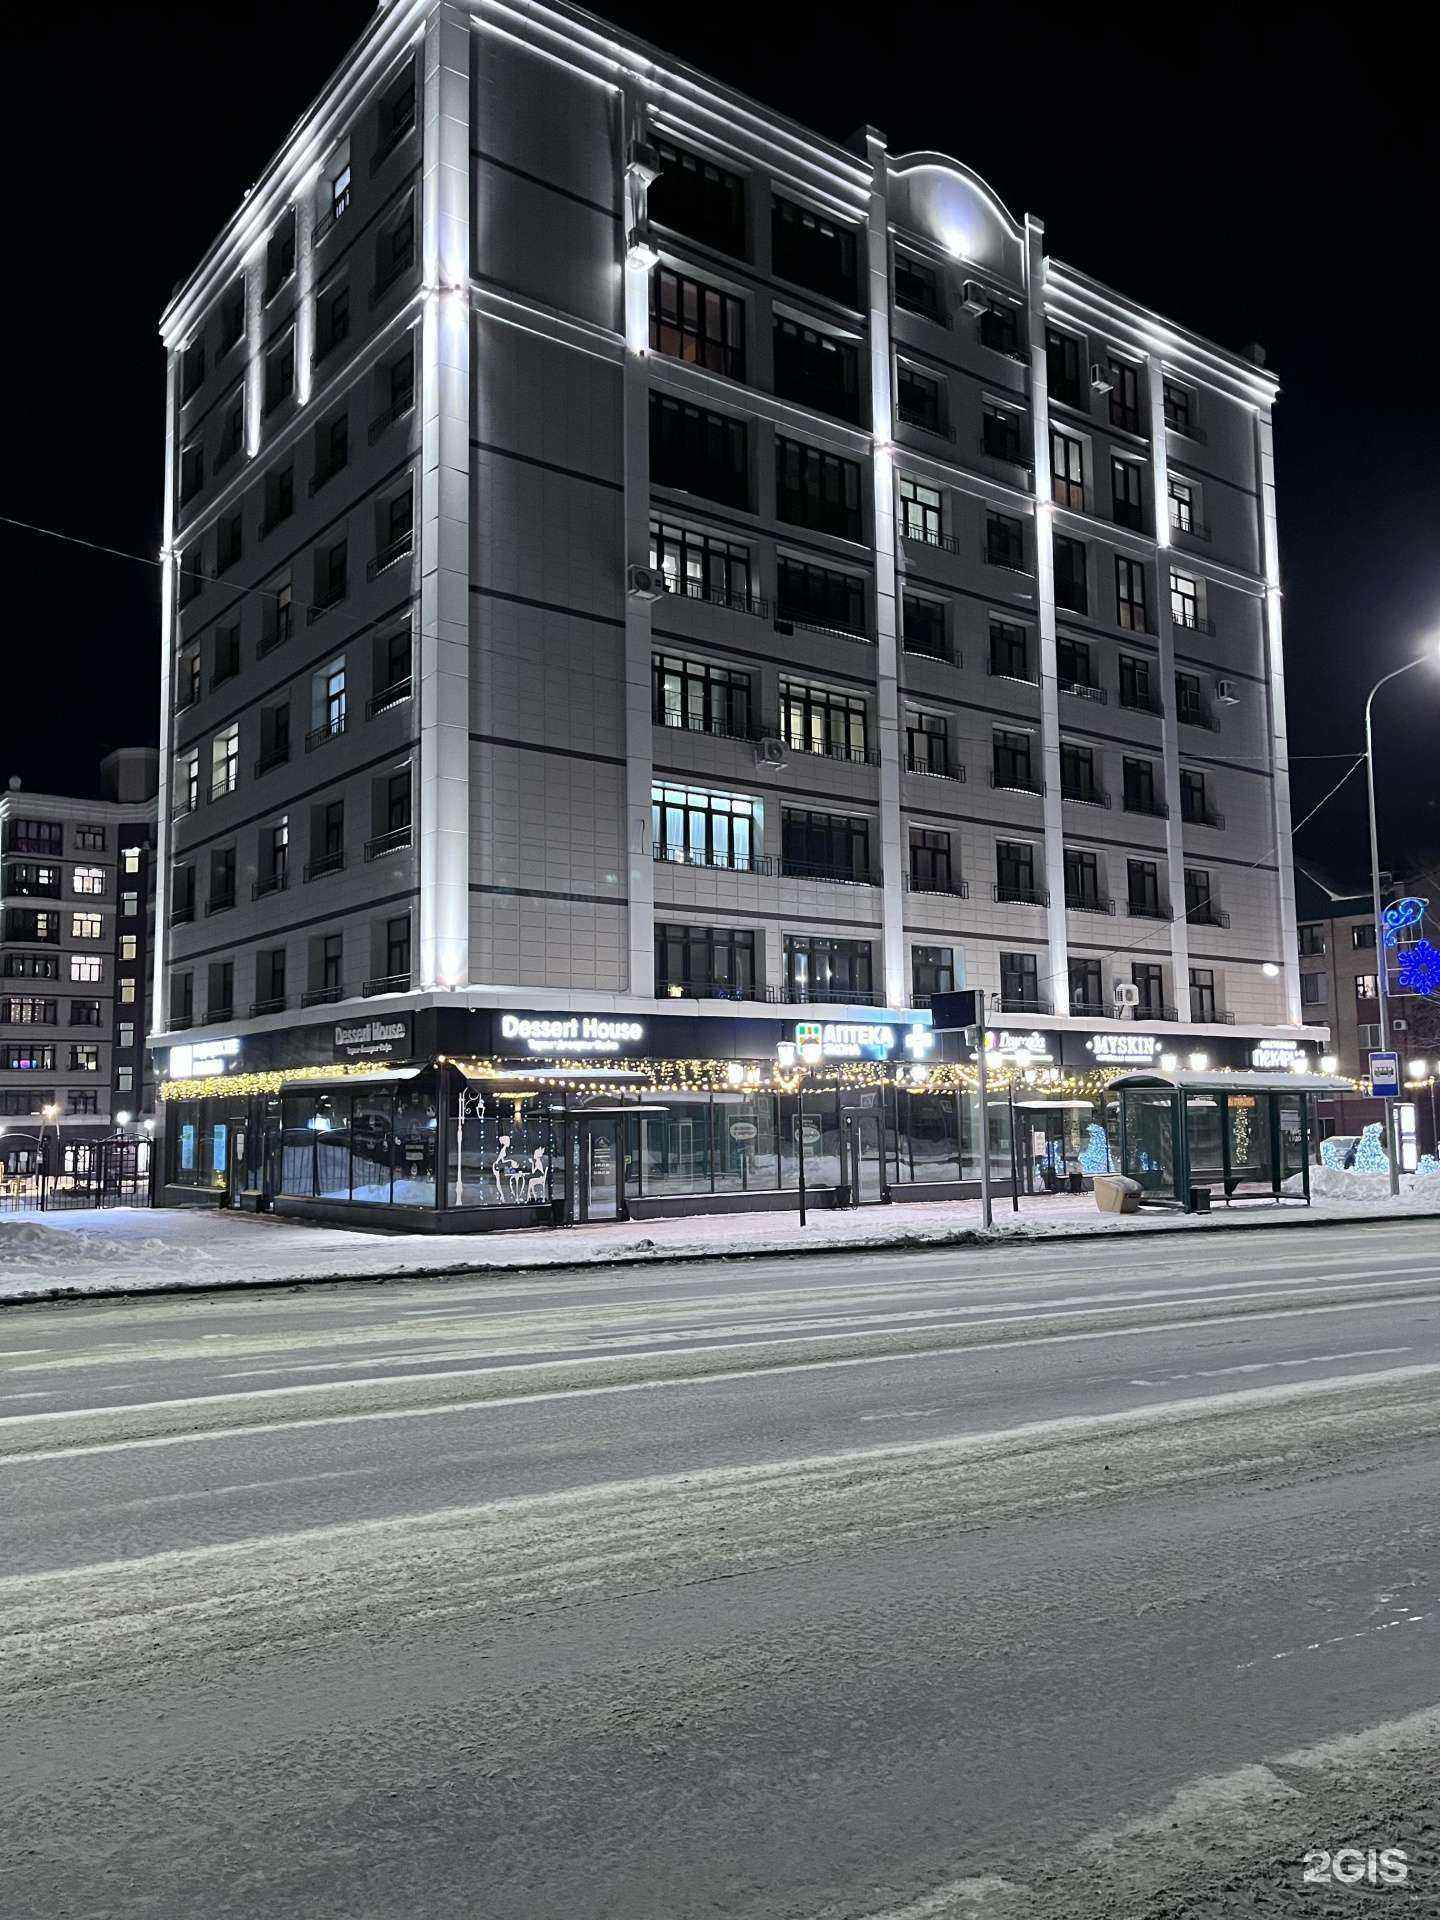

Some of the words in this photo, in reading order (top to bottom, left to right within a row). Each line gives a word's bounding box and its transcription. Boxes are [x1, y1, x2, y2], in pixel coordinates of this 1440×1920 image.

[335, 1024, 371, 1045] Dessert
[372, 1021, 406, 1041] House
[502, 1014, 579, 1038] Dessert
[582, 1017, 643, 1041] House
[824, 1024, 895, 1048] АПТЕКА
